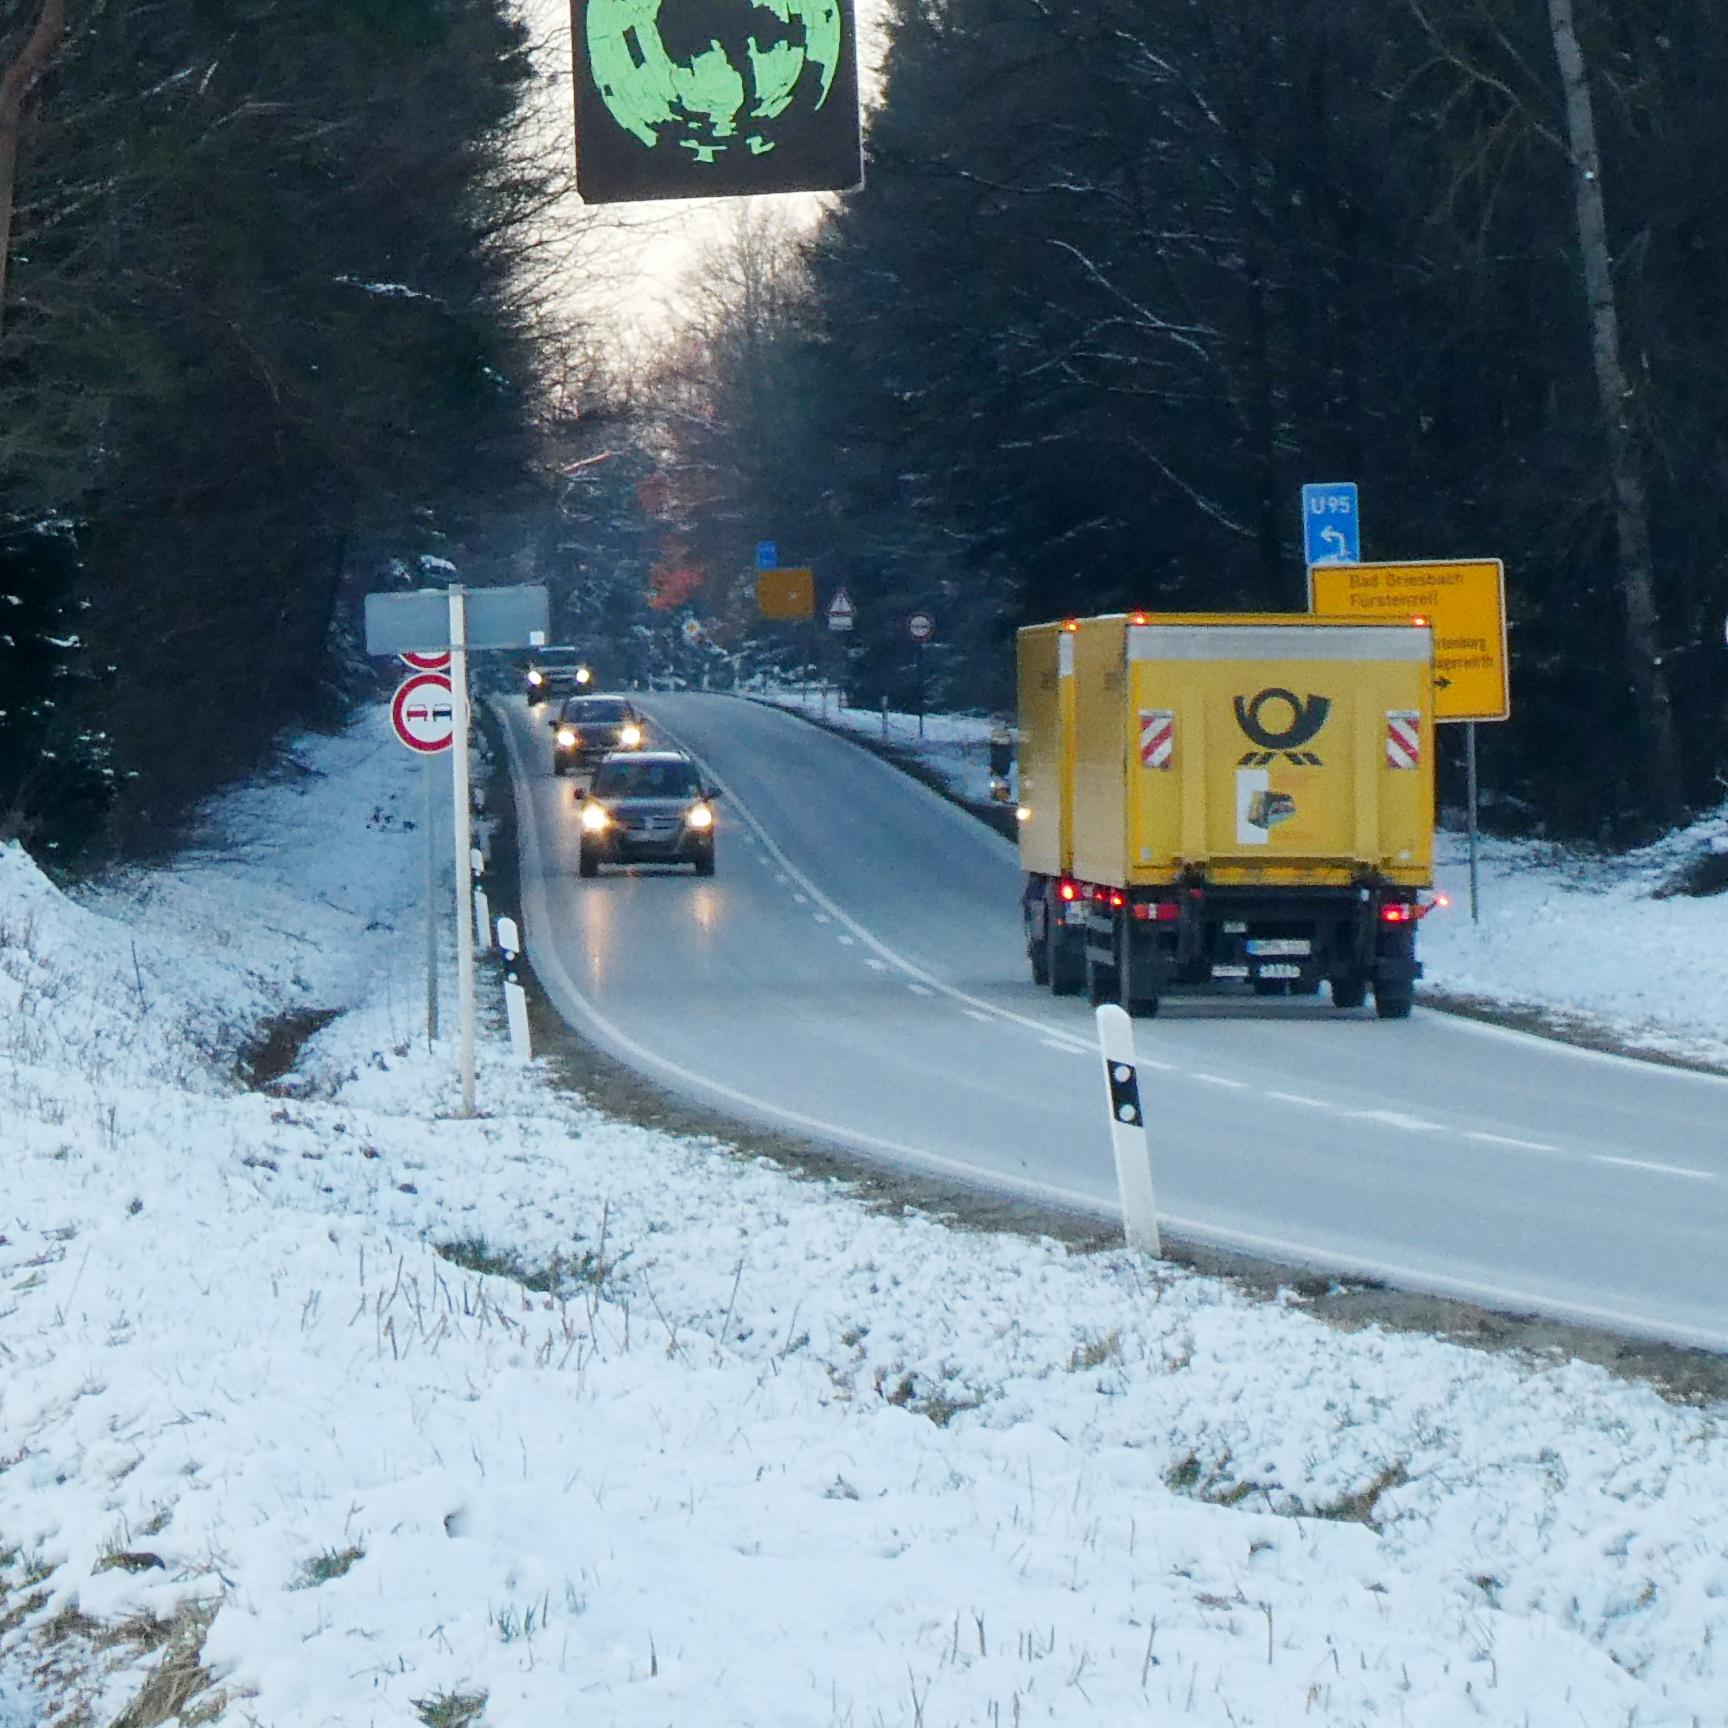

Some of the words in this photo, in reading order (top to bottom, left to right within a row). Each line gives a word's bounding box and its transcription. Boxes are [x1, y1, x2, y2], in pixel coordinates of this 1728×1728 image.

[1349, 574, 1378, 588] Bad
[1385, 572, 1465, 587] Griesbach
[1435, 637, 1487, 652] rtenburg
